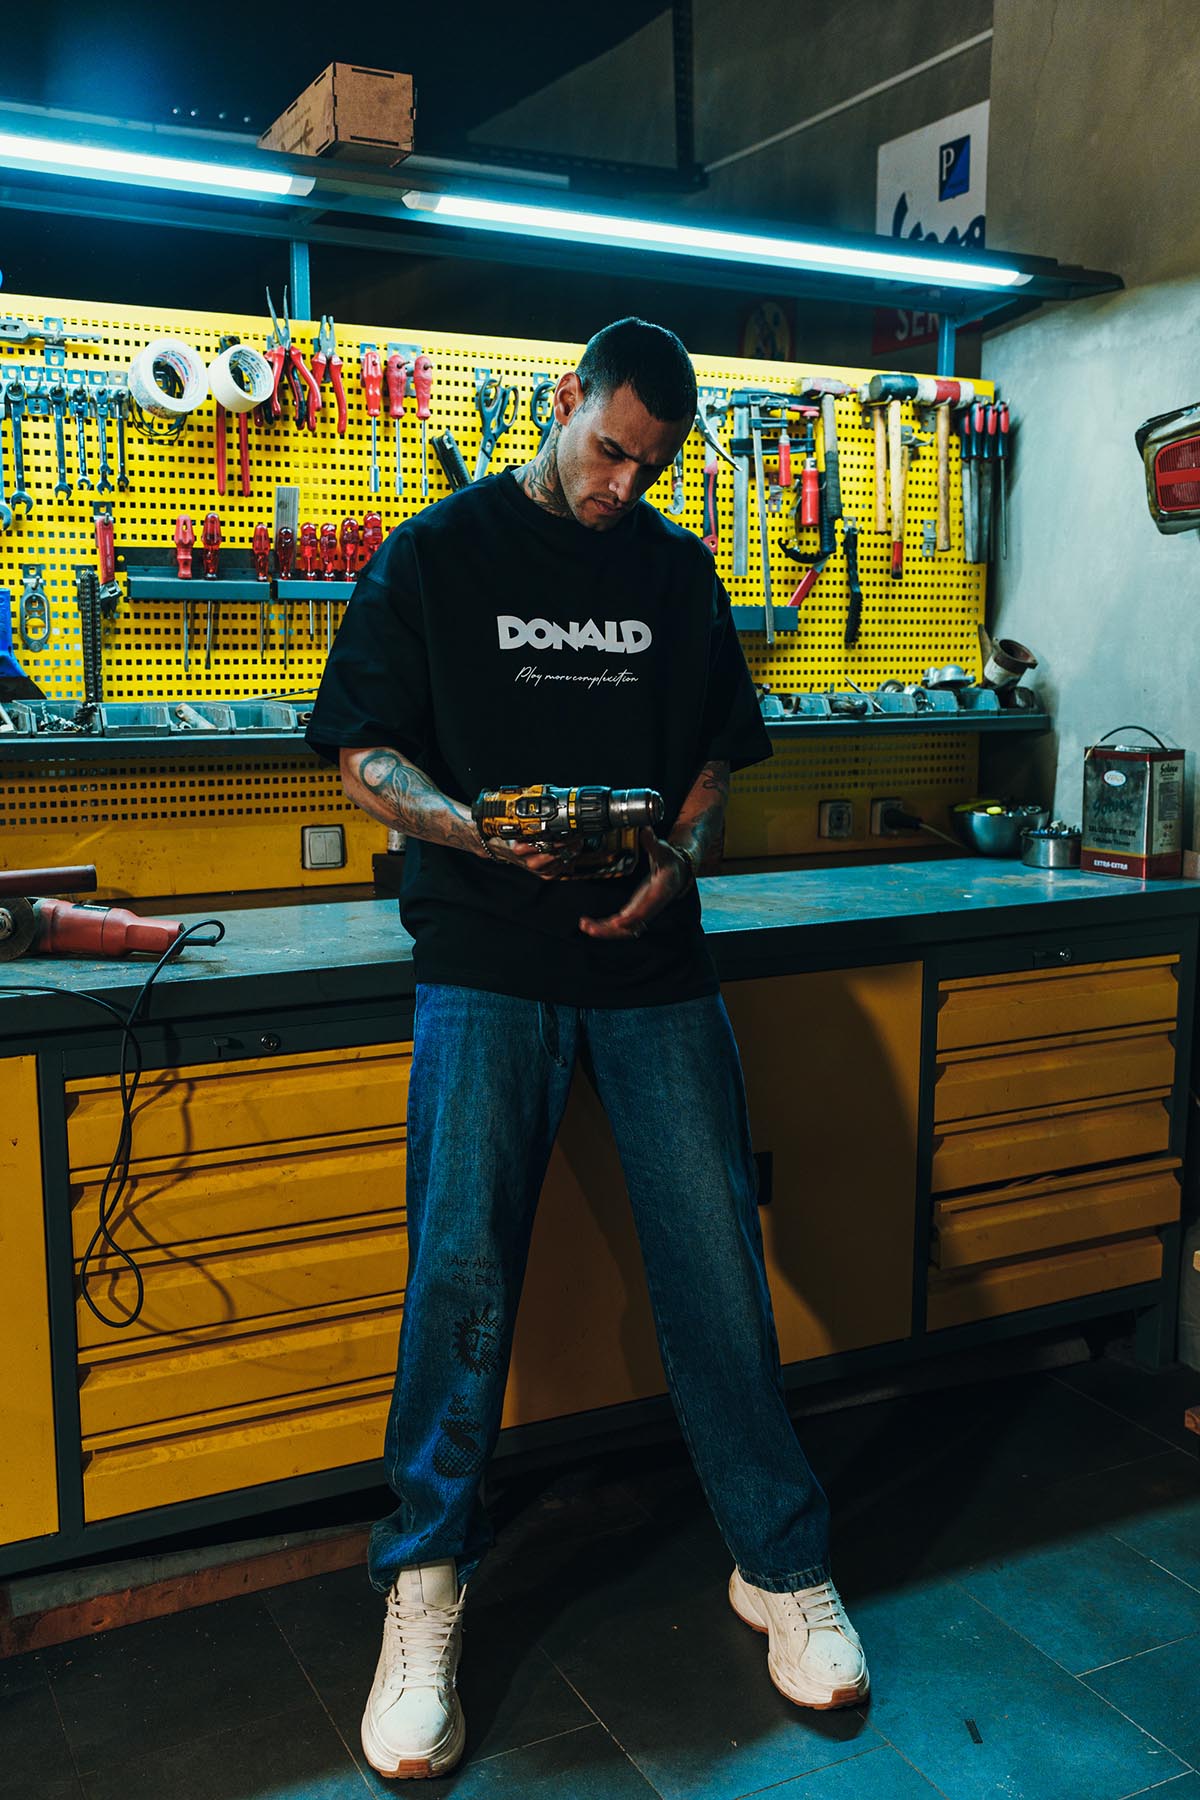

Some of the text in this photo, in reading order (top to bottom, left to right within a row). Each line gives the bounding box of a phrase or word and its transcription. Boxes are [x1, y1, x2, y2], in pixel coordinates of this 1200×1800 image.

[942, 148, 955, 181] P
[496, 615, 653, 654] DONALD
[514, 666, 543, 687] Play
